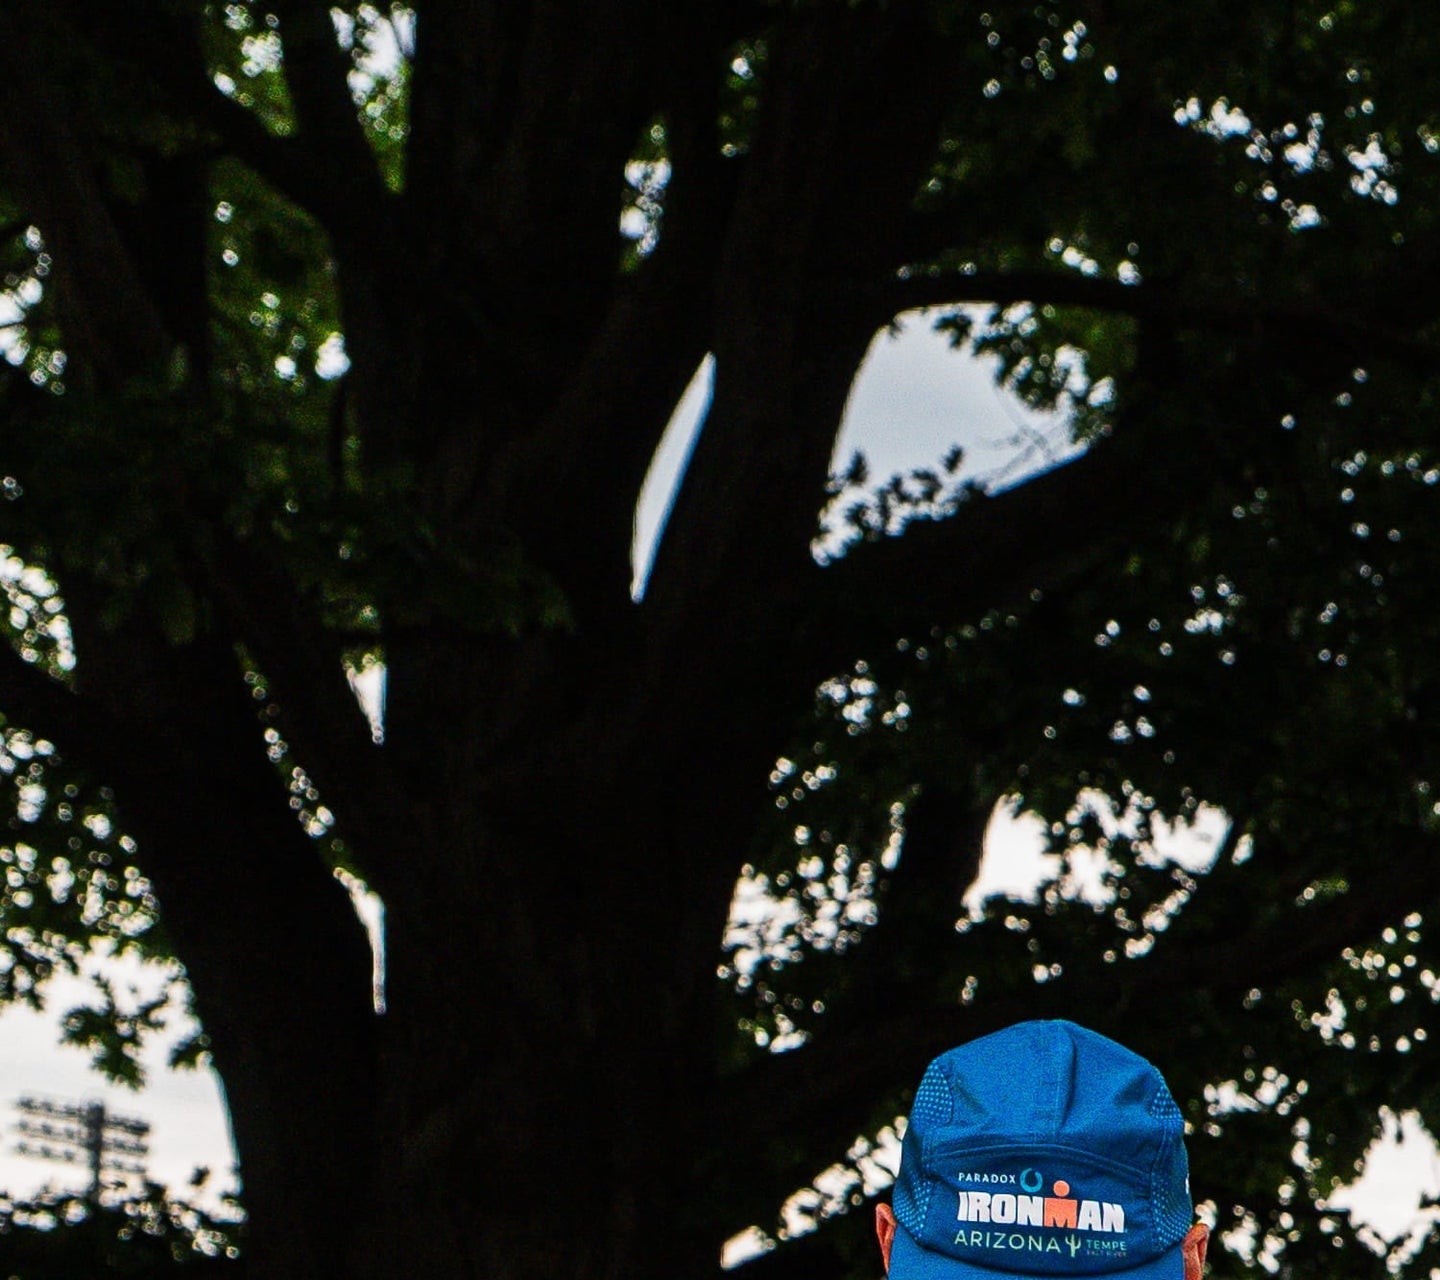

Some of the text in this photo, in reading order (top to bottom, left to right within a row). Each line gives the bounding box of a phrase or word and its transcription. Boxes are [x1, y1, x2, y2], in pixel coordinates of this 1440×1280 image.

[958, 1172, 1016, 1184] PARADOX
[957, 1180, 1125, 1233] IRONMAN
[954, 1230, 1061, 1254] ARIZONA
[1086, 1239, 1127, 1251] TEMPE
